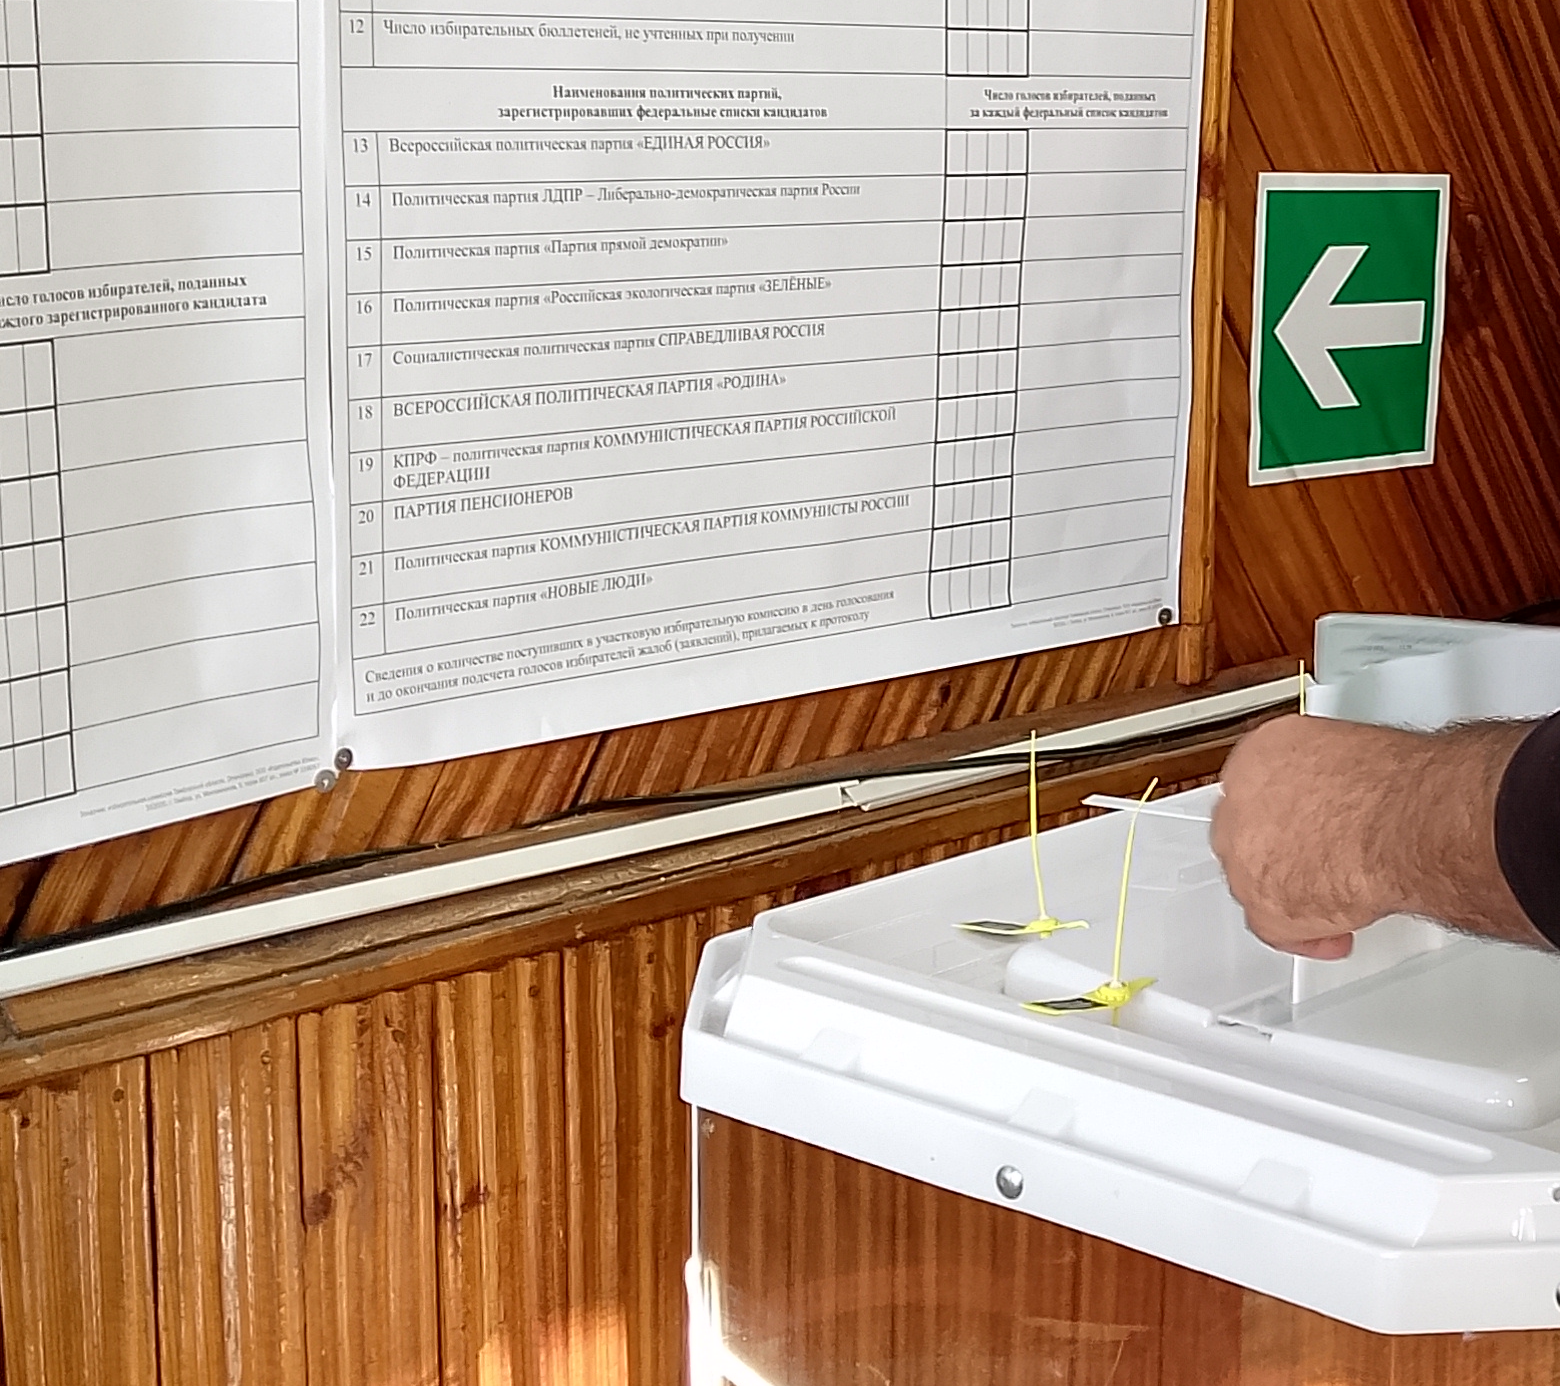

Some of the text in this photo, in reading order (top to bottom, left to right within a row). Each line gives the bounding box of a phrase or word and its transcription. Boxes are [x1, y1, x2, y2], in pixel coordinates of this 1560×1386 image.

[553, 85, 782, 103] Наименования политических партий,
[498, 105, 827, 122] зарегистрировавших федеральные списки кандидатов
[354, 135, 770, 156] 13 Всероссийская политическая партия «ЕДИНАЯ РОССИЯ»
[357, 192, 370, 207] 14
[392, 191, 489, 207] Политическая
[493, 193, 538, 208] партия
[542, 187, 582, 205] ЛДПР
[597, 186, 776, 204] Либерально-демократическая
[781, 186, 818, 201] партия
[822, 182, 860, 196] России
[357, 236, 728, 262] 15 Политическая партия «Партия прямой демократии»
[0, 277, 247, 307] сло голосов избирателей, поданных
[358, 276, 831, 314] 16 Политическая партия «Российская экологическая партия «ЗЕЛЁНЫЕ»
[0, 296, 267, 329] ждого зарегистрированного кандидата
[358, 322, 824, 367] 17 Социалистическая политическая партия СПРАВЕДЛИВАЯ РОССИЯ
[359, 373, 786, 420] 18 ВСЕРОССИЙСКАЯ ПОЛИТИЧЕСКАЯ ПАРТИЯ «РОДИНА»
[359, 572, 652, 627] 22 Политическая партия «НОВЫЕ ЛЮДИ»
